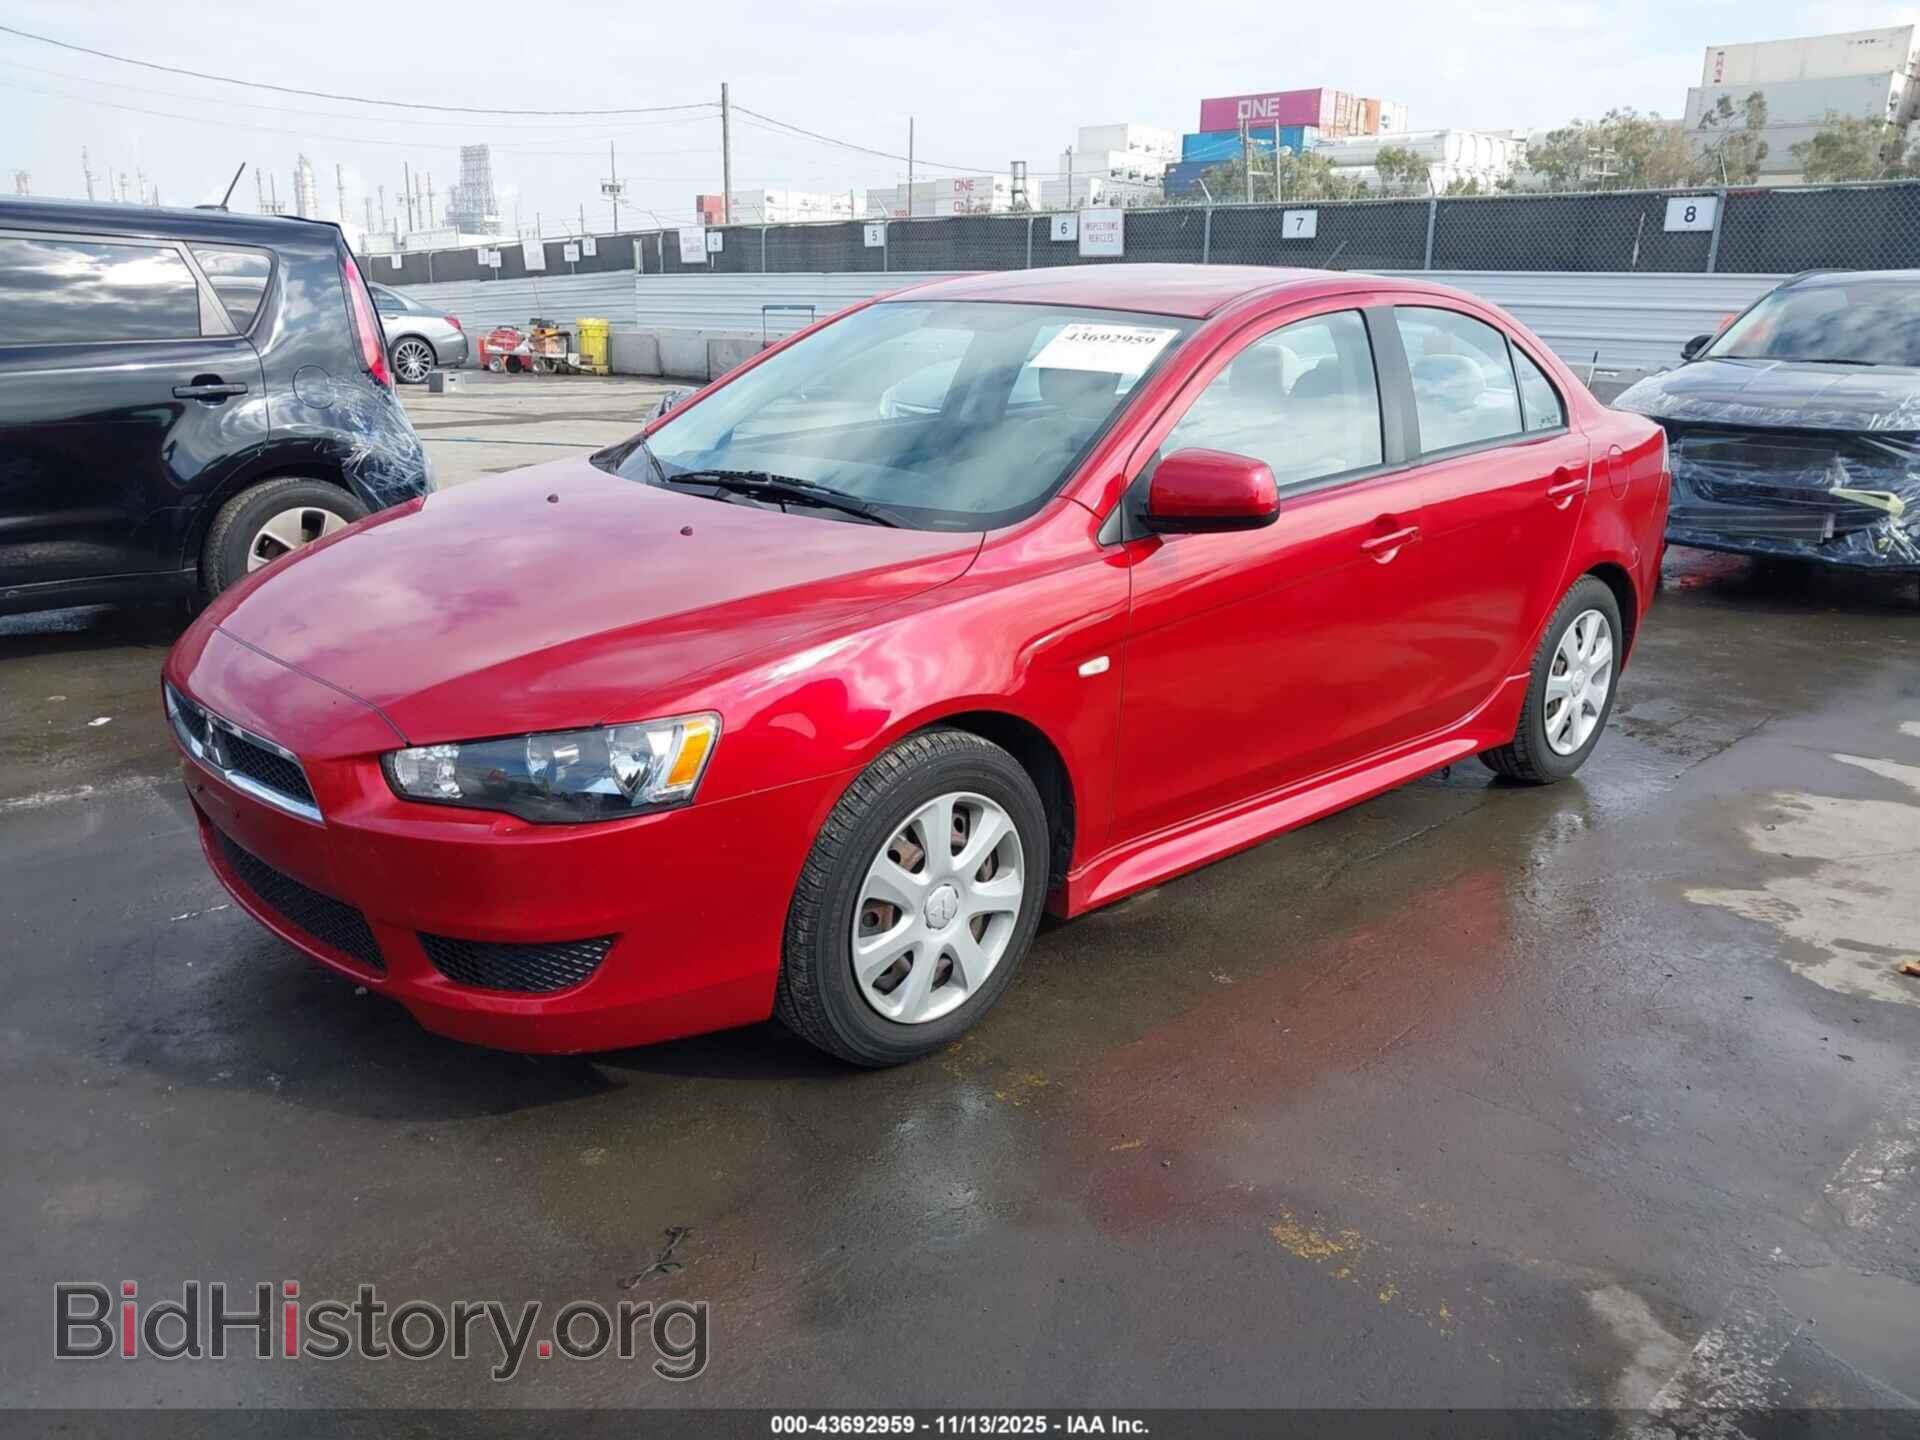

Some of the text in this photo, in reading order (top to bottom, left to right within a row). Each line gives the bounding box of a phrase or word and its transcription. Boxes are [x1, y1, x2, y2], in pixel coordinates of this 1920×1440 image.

[1238, 97, 1280, 119] ONE
[953, 179, 975, 192] ONE
[1684, 205, 1697, 223] 8
[1060, 222, 1068, 235] 6
[1296, 217, 1304, 231] 7
[872, 230, 878, 241] 5
